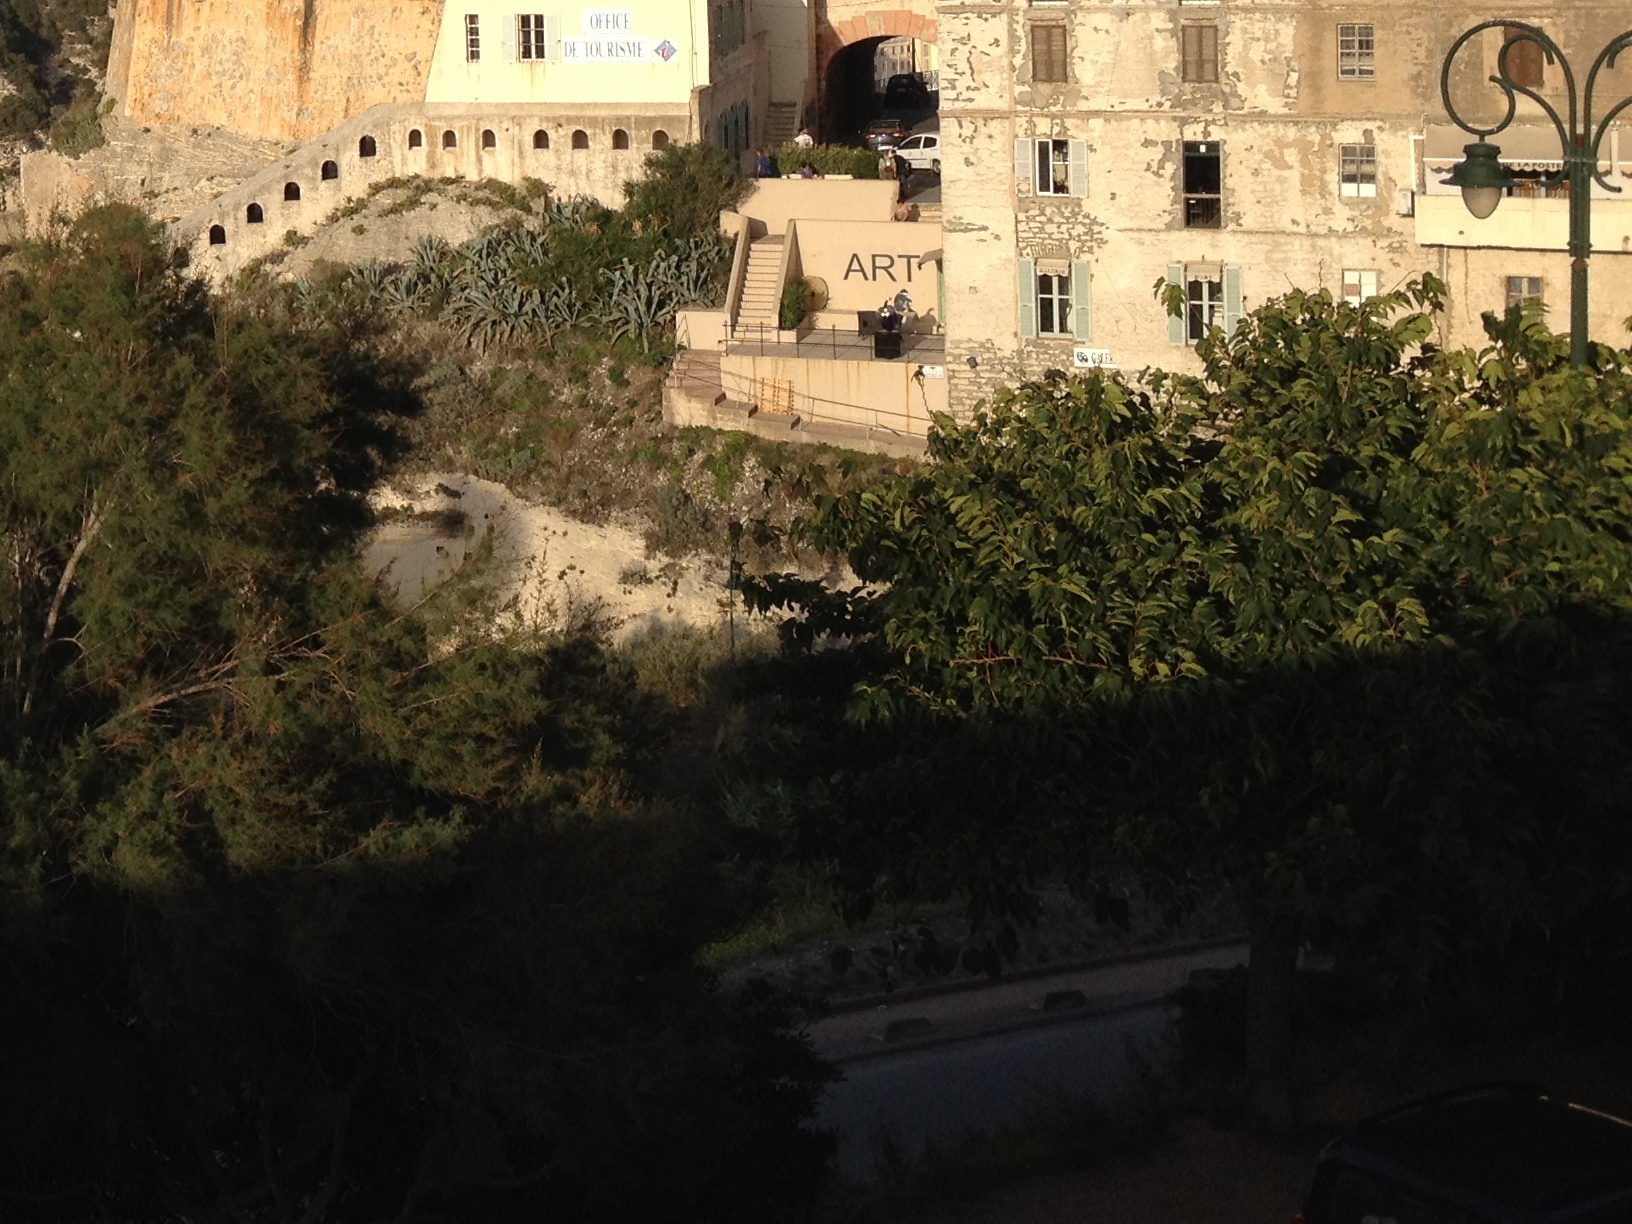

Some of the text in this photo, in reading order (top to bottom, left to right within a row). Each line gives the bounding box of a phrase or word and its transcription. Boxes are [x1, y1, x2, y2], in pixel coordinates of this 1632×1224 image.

[590, 13, 631, 30] OFFICE
[564, 41, 644, 58] DE TOURISME
[843, 253, 921, 282] ART
